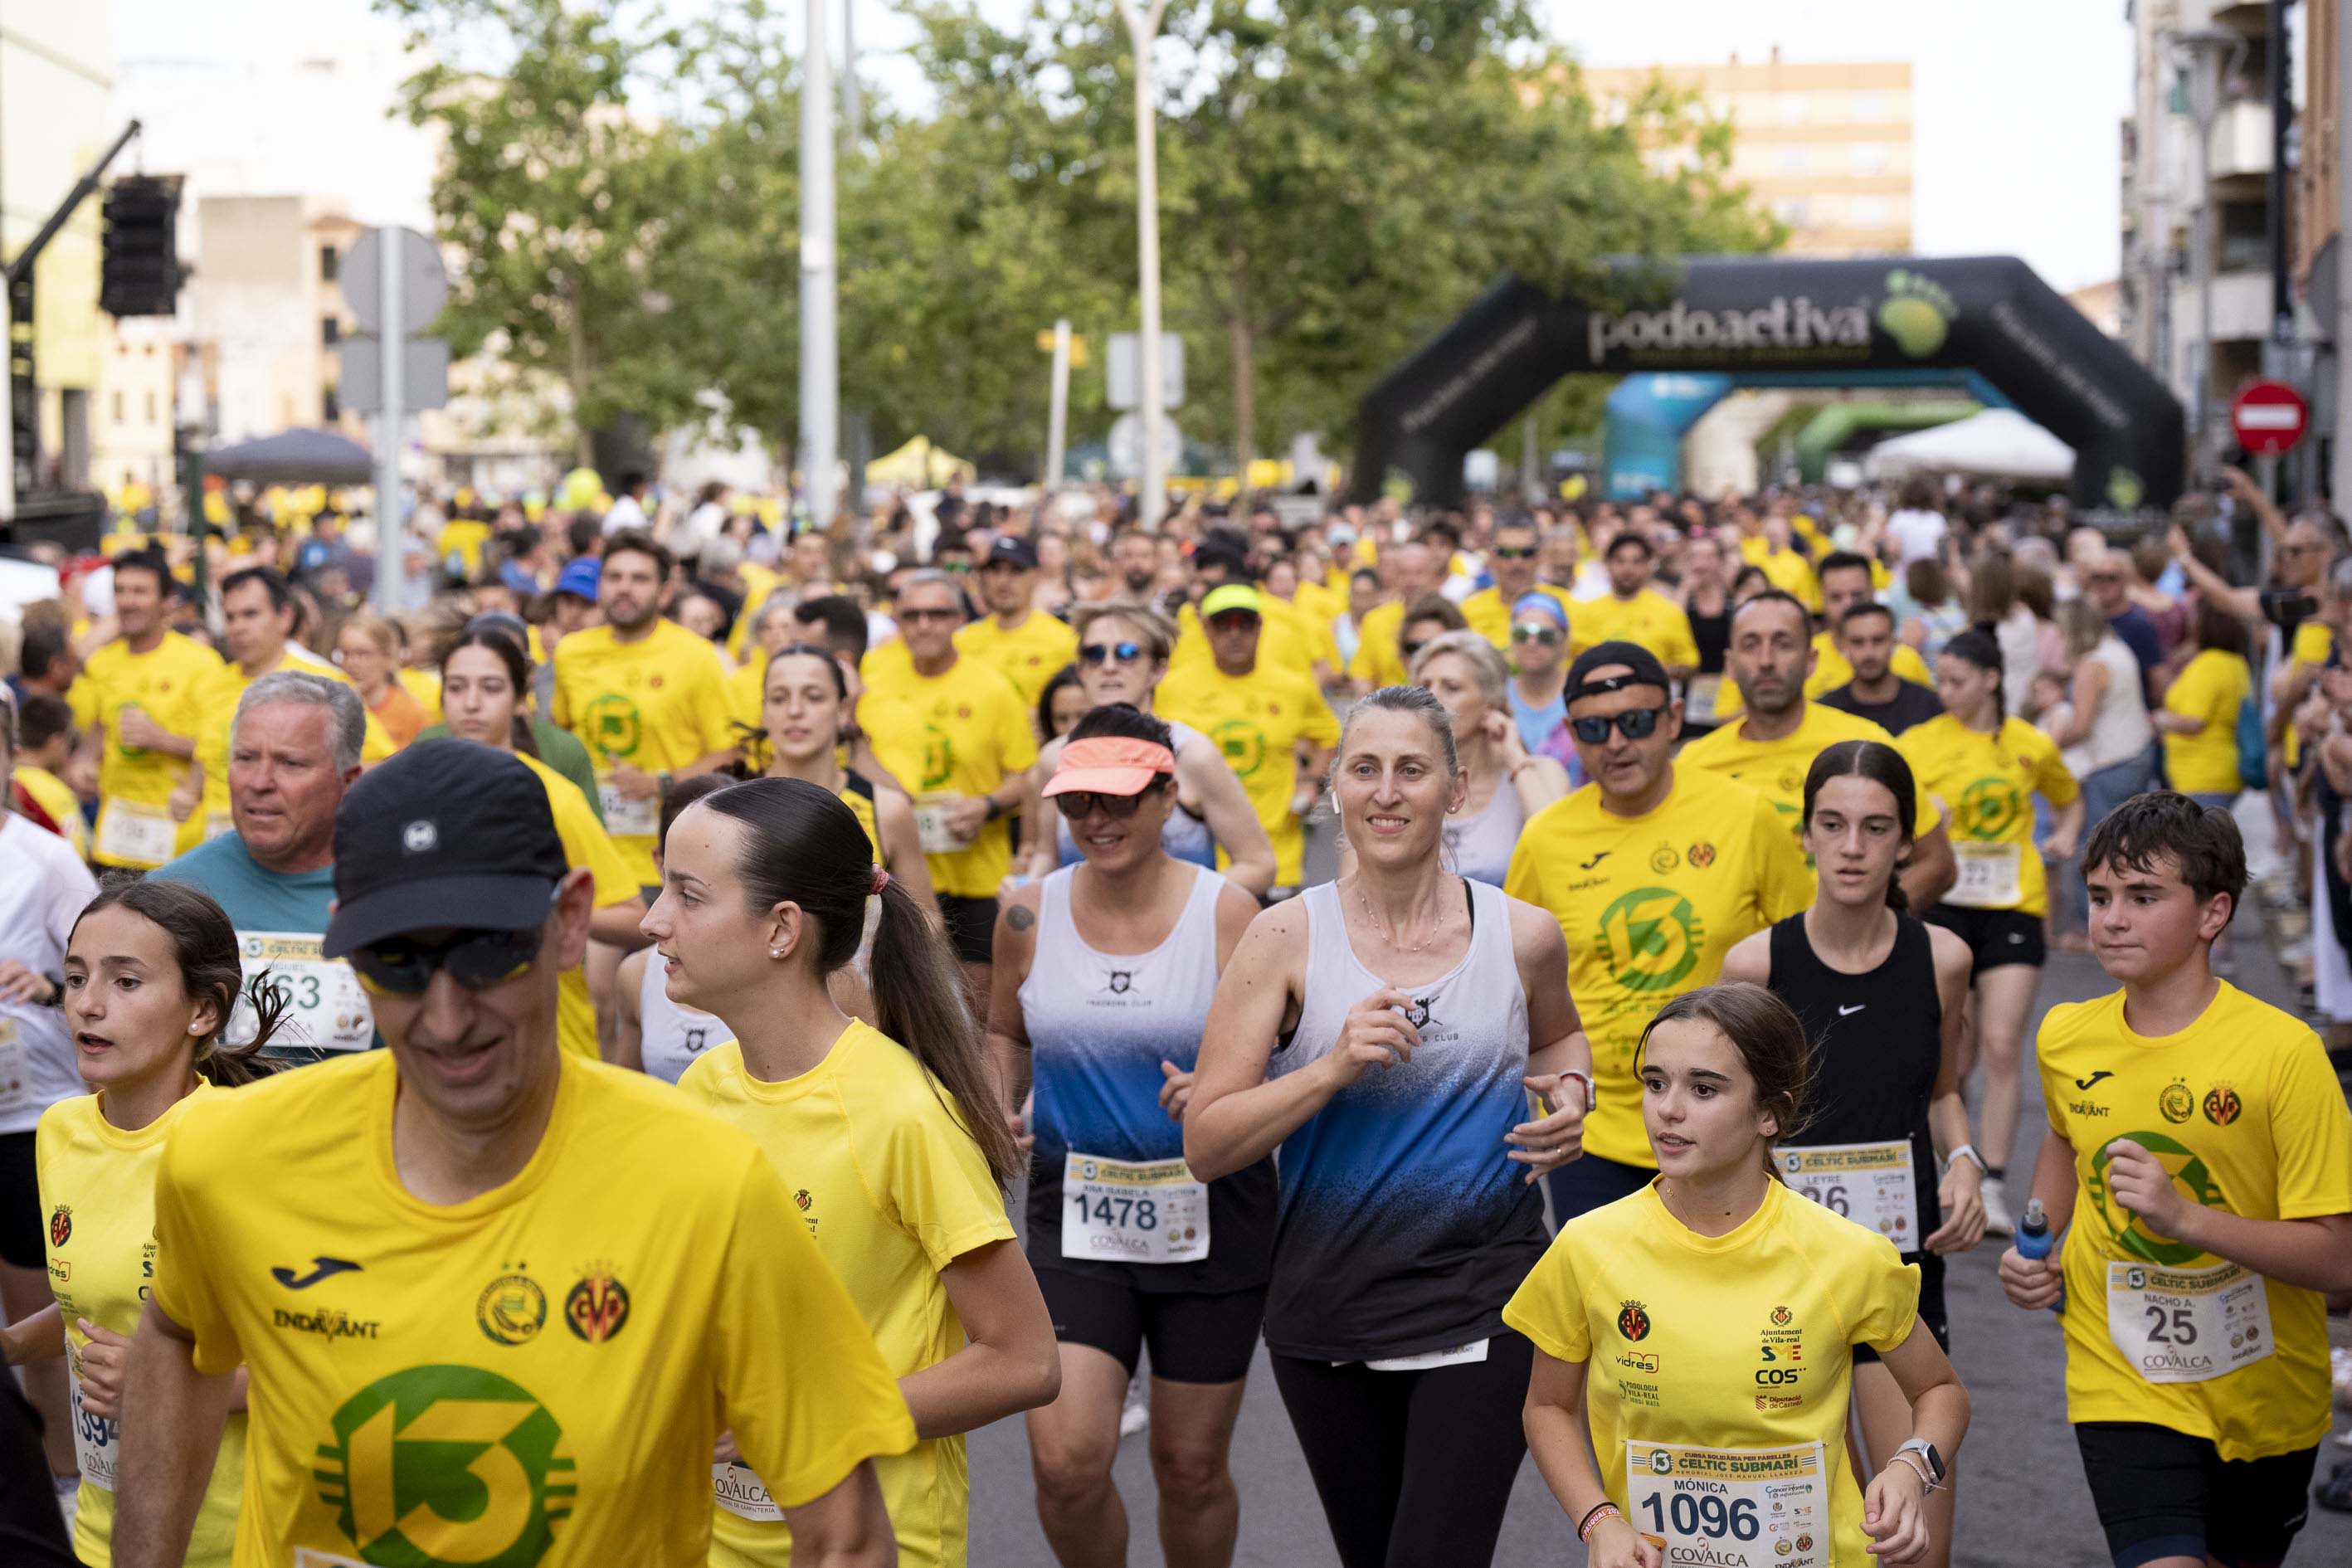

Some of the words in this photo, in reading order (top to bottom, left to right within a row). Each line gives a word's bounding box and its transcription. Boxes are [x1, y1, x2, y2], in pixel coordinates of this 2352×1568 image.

[1588, 296, 1869, 365] podoactiva
[1434, 1033, 1458, 1042] CLUB
[1074, 1194, 1157, 1232] 1478
[2150, 1274, 2186, 1288] CELTIC
[2144, 1293, 2181, 1307] NACHO
[2184, 1298, 2197, 1308] A.
[1760, 1328, 1802, 1337] Ajuntament
[2145, 1306, 2198, 1346] 25
[1770, 1336, 1799, 1344] Vila-real
[1615, 1356, 1654, 1371] vidres
[2144, 1355, 2213, 1369] COVALCA
[1755, 1368, 1799, 1385] COS
[85, 1453, 119, 1475] COVAL
[1678, 1458, 1727, 1472] CELTIC
[1731, 1455, 1799, 1473] SUBMARÍ
[1757, 1453, 1791, 1461] PARELLES
[713, 1478, 774, 1502] OVALCA
[1673, 1478, 1729, 1495] MÓNICA
[1642, 1492, 1760, 1541] 1096
[1670, 1546, 1749, 1567] COVALCA
